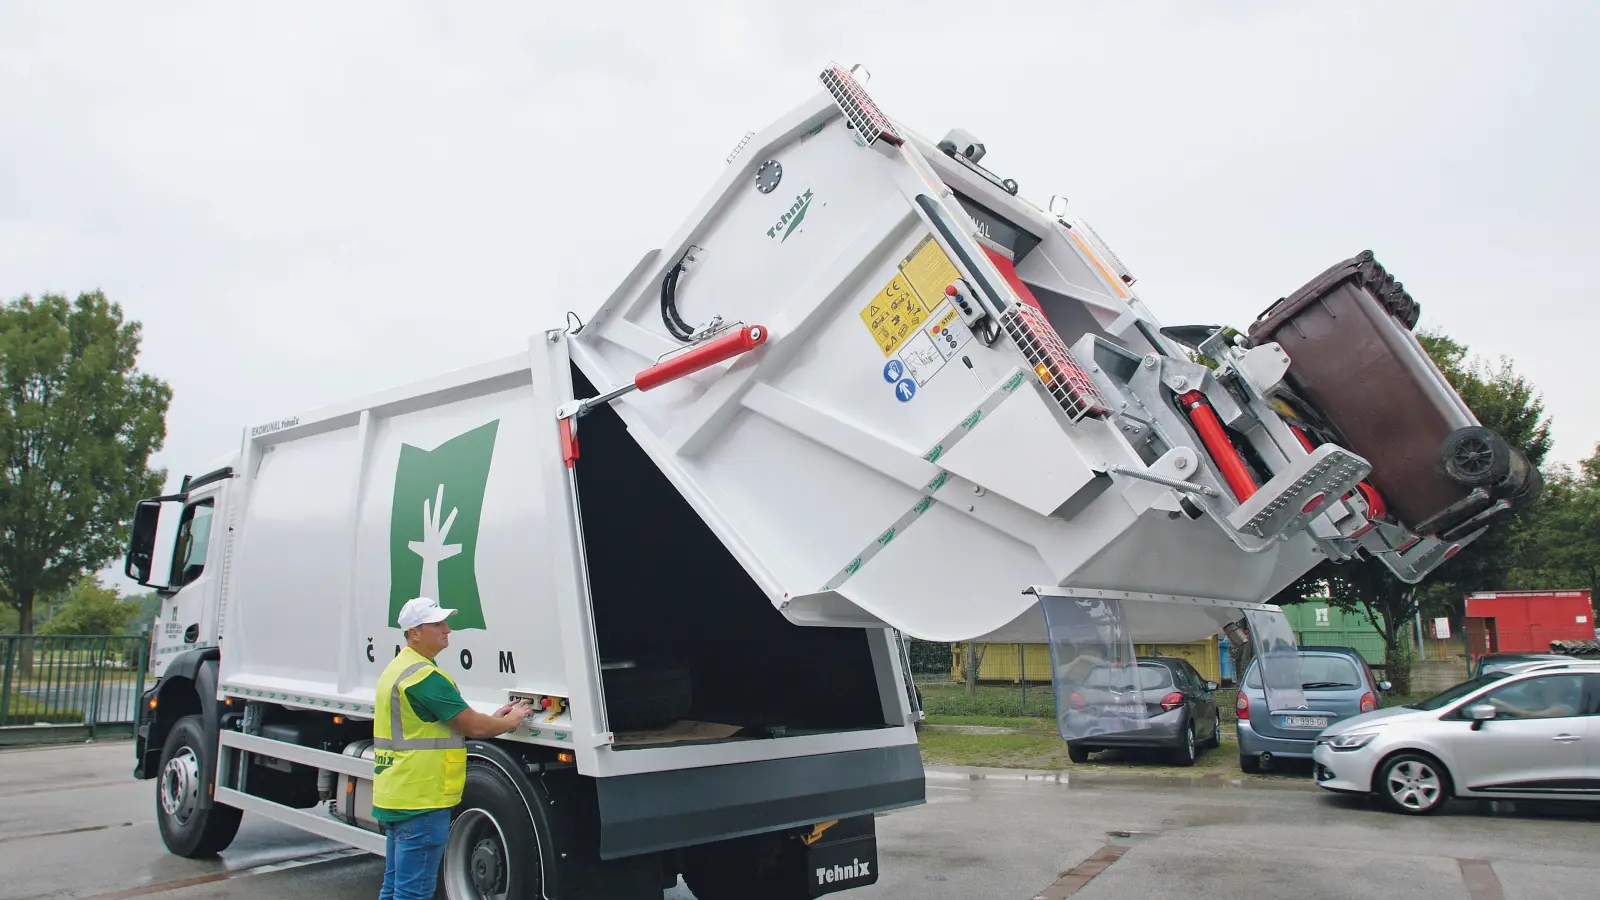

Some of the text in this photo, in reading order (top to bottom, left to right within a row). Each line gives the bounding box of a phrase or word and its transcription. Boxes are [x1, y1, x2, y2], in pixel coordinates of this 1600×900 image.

[766, 187, 814, 239] Tehnix
[941, 311, 955, 326] STOP
[1002, 371, 1025, 391] Tehnix
[252, 416, 300, 436] EKOMUNAL Tehnix
[961, 409, 982, 428] Tehnix
[928, 471, 948, 489] Tehnix
[913, 496, 932, 513] Tehnix
[878, 527, 896, 544] Tehnix
[845, 558, 862, 574] Tehnix
[366, 637, 516, 674] ČOM
[816, 857, 871, 885] Tehnix
